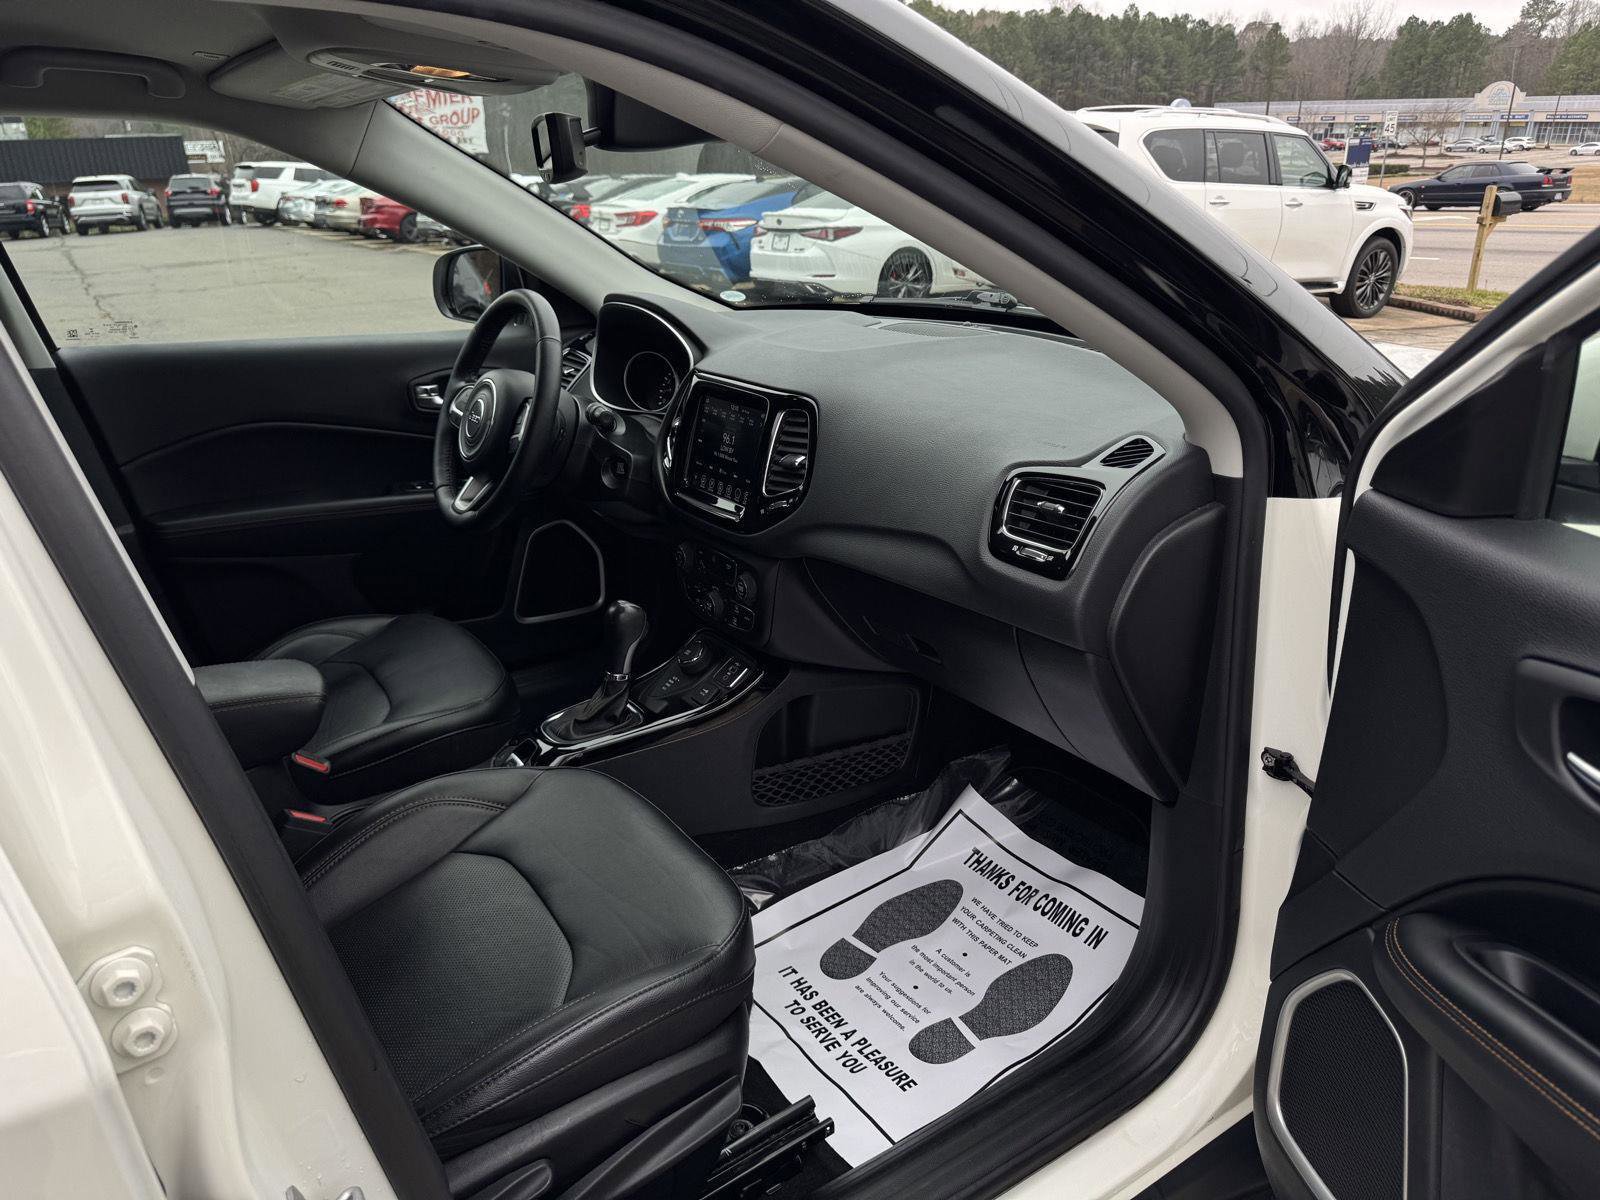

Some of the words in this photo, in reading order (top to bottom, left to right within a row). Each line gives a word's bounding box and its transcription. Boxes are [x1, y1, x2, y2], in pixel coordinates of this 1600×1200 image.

[429, 107, 480, 126] GROUP
[1385, 123, 1395, 133] 45
[963, 847, 1016, 890] THANKS
[1007, 880, 1040, 906] FOR
[1032, 893, 1090, 938] COMING
[1083, 924, 1109, 950] IN
[971, 897, 982, 907] WE
[980, 905, 997, 920] HAVE
[996, 918, 1013, 932] TRIED
[1012, 930, 1022, 938] TO
[1021, 936, 1039, 948] KEEP
[952, 917, 967, 931] WITH
[966, 929, 980, 942] THIS
[978, 940, 999, 957] PAPER
[997, 954, 1012, 966] MAT
[960, 905, 976, 921] YOUR
[975, 919, 1008, 945] CARPETING
[1006, 943, 1028, 959] CLEAN
[911, 944, 920, 953] the
[919, 952, 934, 964] most
[932, 962, 957, 982] important
[955, 981, 976, 996] person
[915, 964, 924, 972] the
[923, 971, 941, 984] world
[941, 953, 966, 973] customer
[855, 985, 865, 993] are
[864, 993, 882, 1009] always
[865, 977, 891, 1000] improving
[890, 999, 902, 1008] our
[900, 1008, 920, 1024] service
[880, 971, 892, 983] Your
[891, 982, 922, 1009] suggestions
[922, 1006, 931, 1015] for
[778, 965, 799, 978] IT
[790, 976, 819, 1001] HAS
[811, 999, 849, 1029] BEEN
[840, 1029, 857, 1041] A
[850, 1036, 919, 1092] PLEASURE
[784, 999, 806, 1016] TO
[799, 1015, 842, 1053] SERVE
[835, 1050, 868, 1074] YOU
